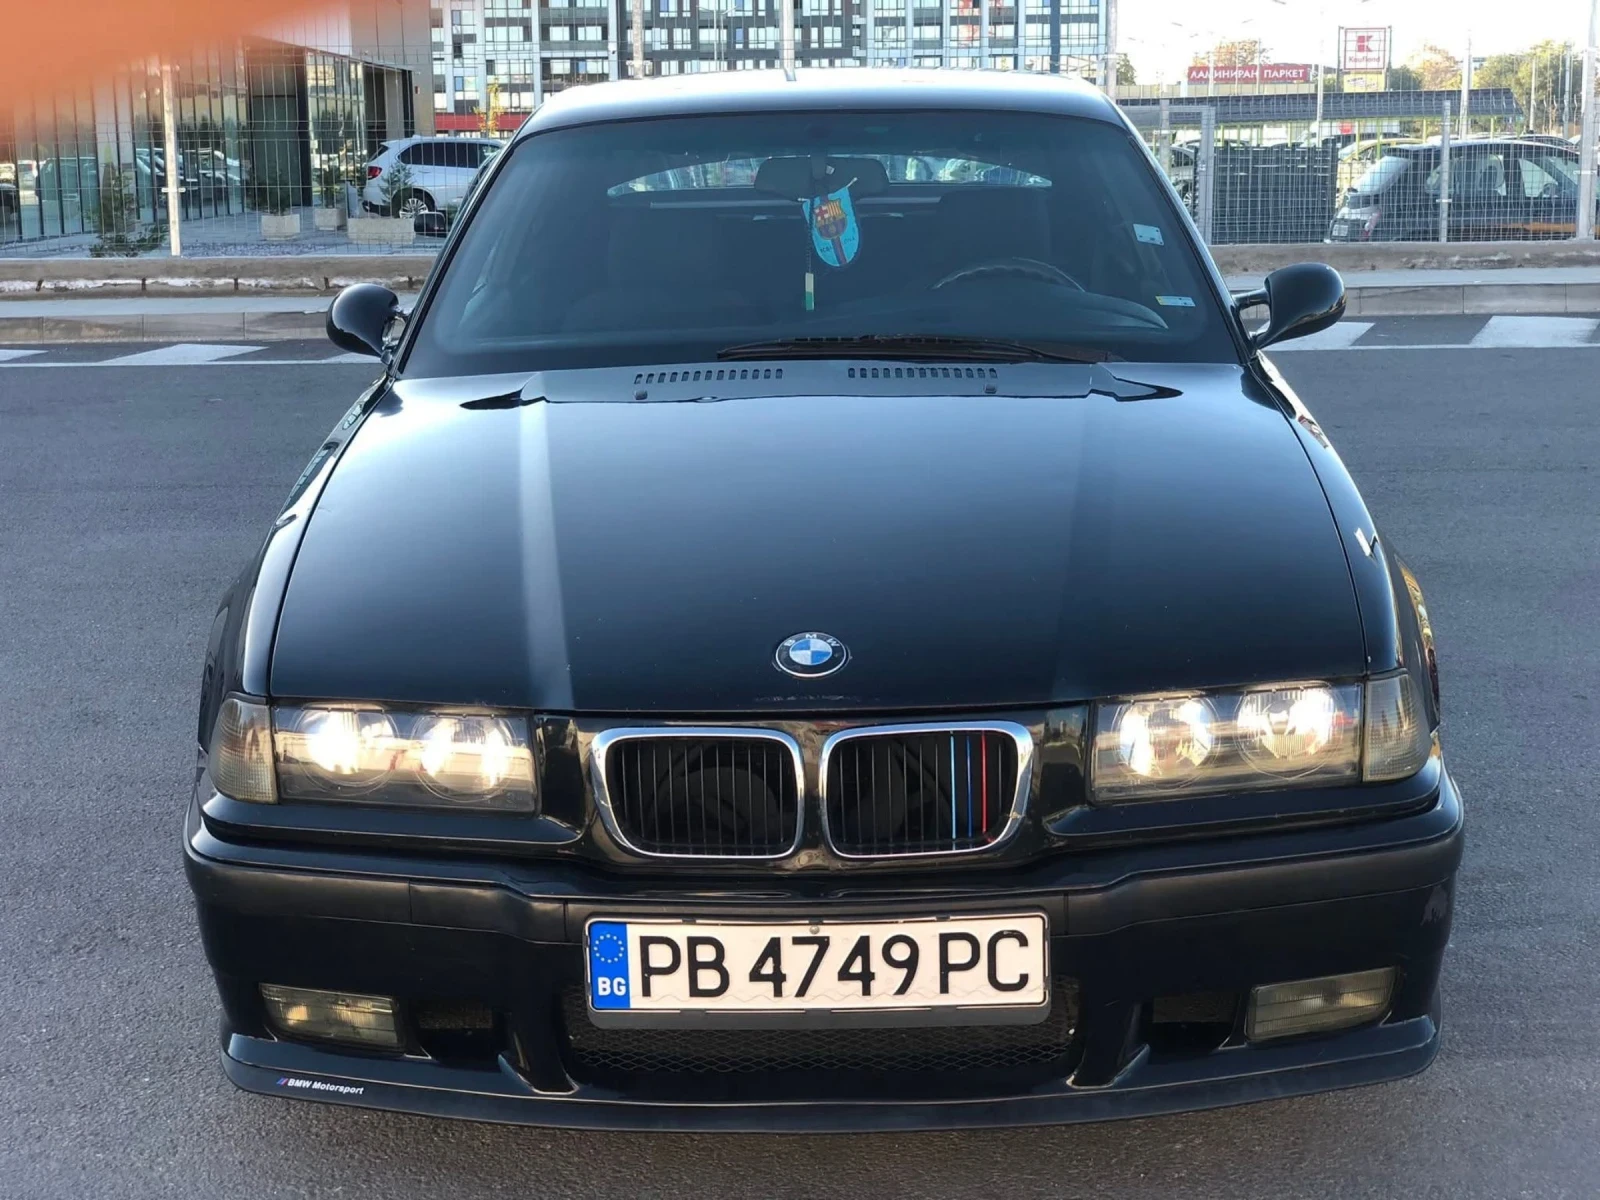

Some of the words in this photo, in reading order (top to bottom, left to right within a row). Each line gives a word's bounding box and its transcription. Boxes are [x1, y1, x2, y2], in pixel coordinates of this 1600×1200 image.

[1263, 68, 1304, 78] ПАРКЕТ
[783, 633, 841, 647] BMW
[748, 934, 920, 998] 4749
[597, 976, 627, 996] BG
[287, 1078, 312, 1089] BMW
[312, 1082, 364, 1095] Motorsport
